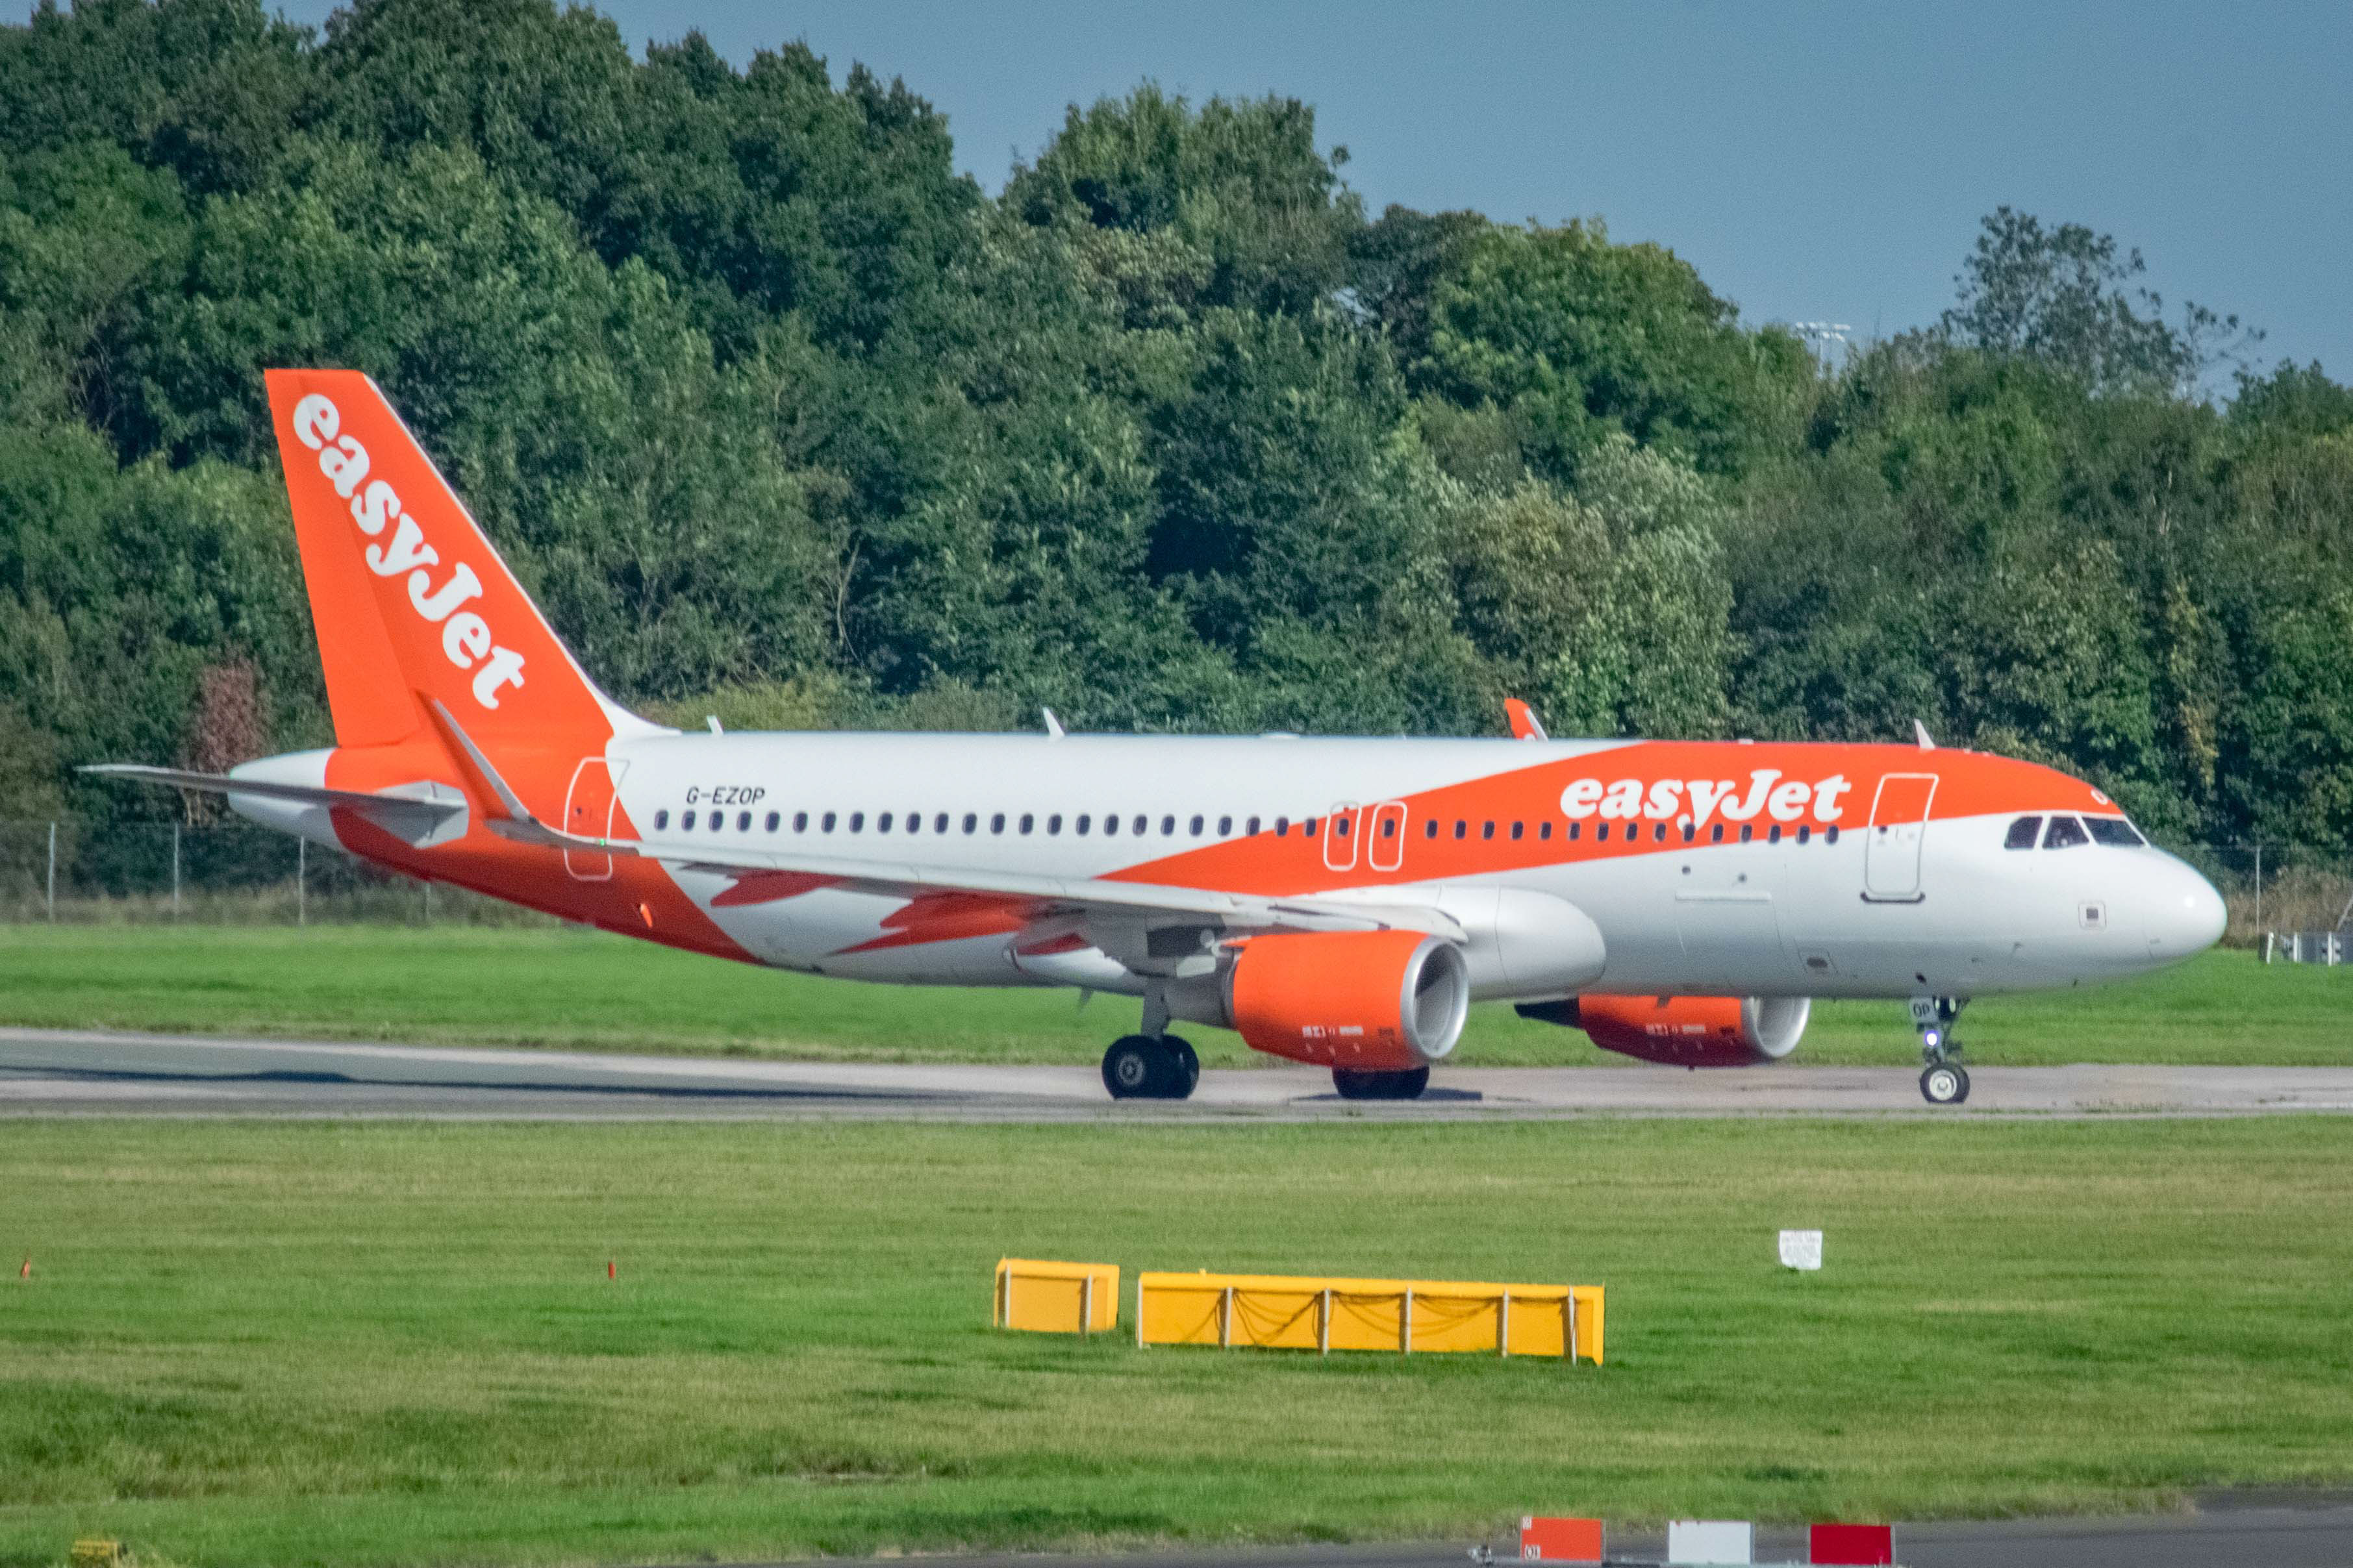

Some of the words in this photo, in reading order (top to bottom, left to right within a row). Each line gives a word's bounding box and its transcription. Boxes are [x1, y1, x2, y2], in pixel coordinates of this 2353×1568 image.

[293, 393, 525, 710] easyJet
[686, 786, 765, 804] G-EZOP
[1560, 769, 1851, 832] easyJet
